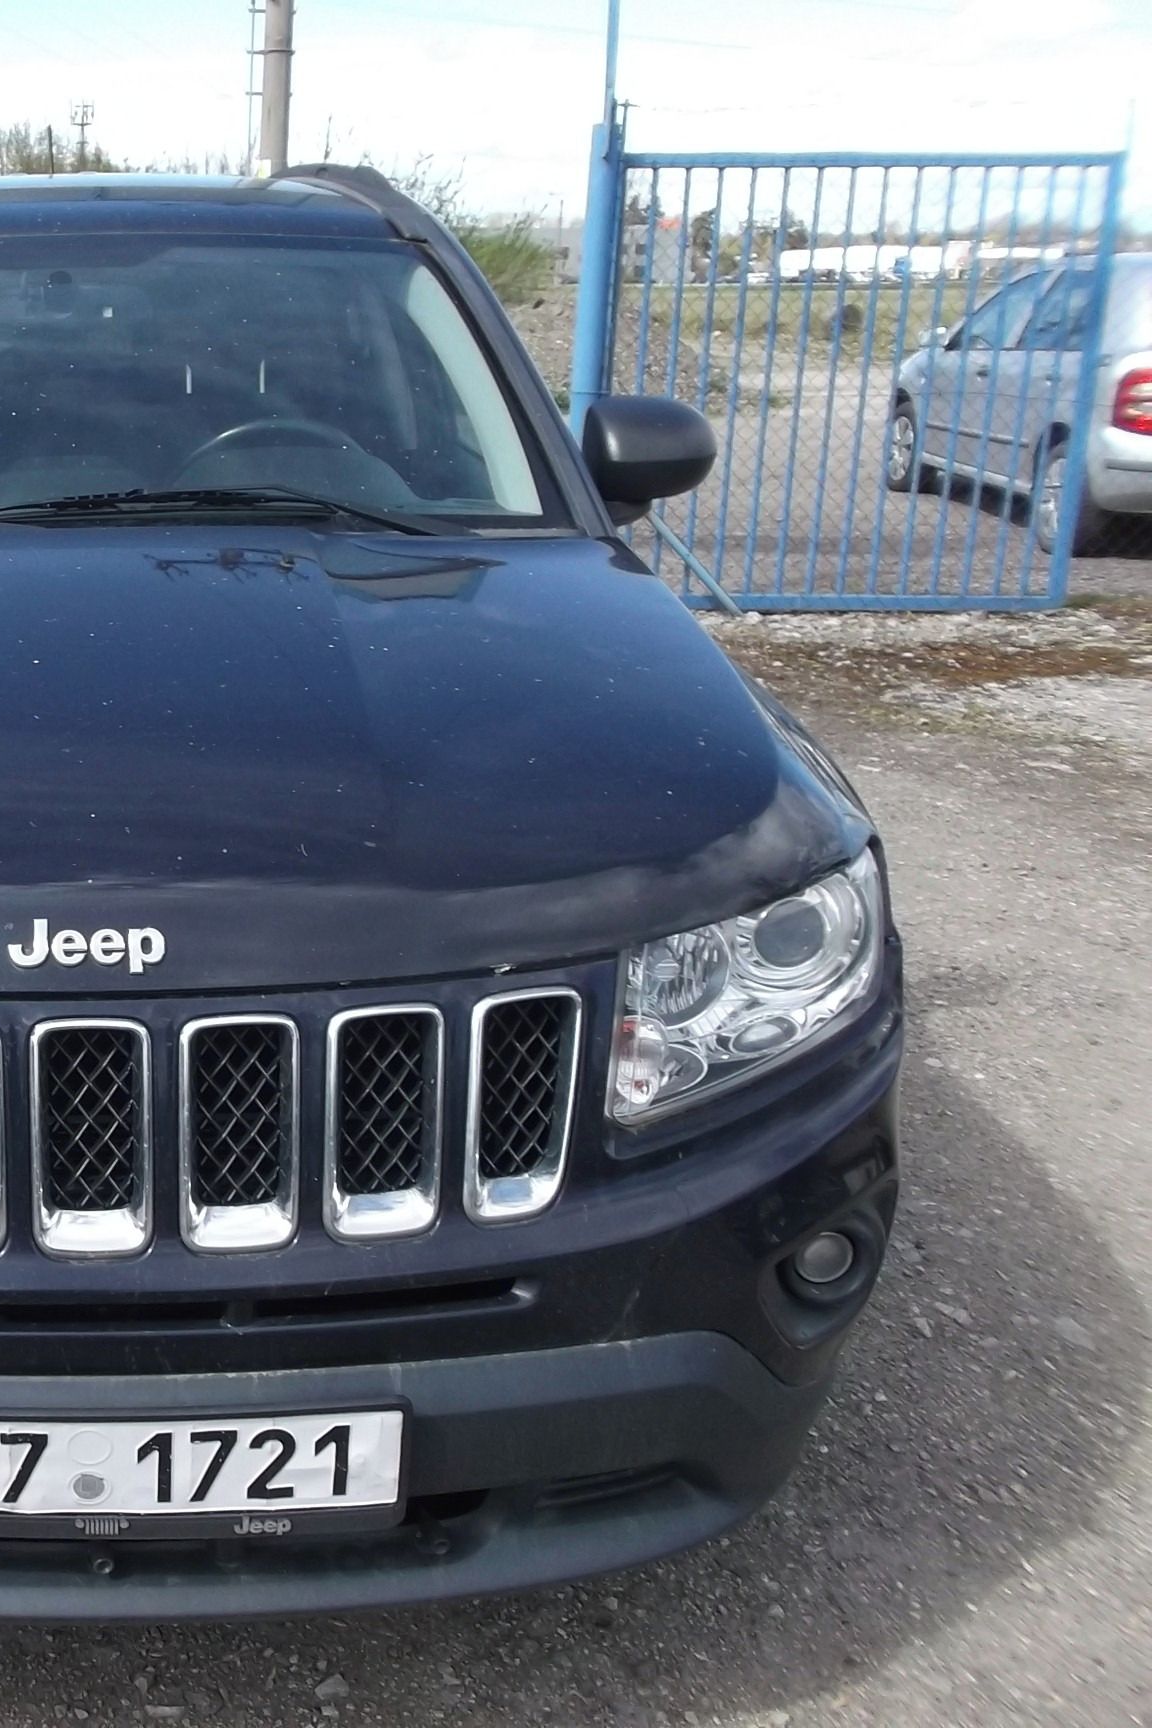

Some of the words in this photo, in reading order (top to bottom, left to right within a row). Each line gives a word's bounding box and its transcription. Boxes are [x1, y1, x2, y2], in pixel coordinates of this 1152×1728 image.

[7, 918, 166, 975] Jeep
[136, 1424, 352, 1503] 1721
[233, 1513, 292, 1536] Jeep
